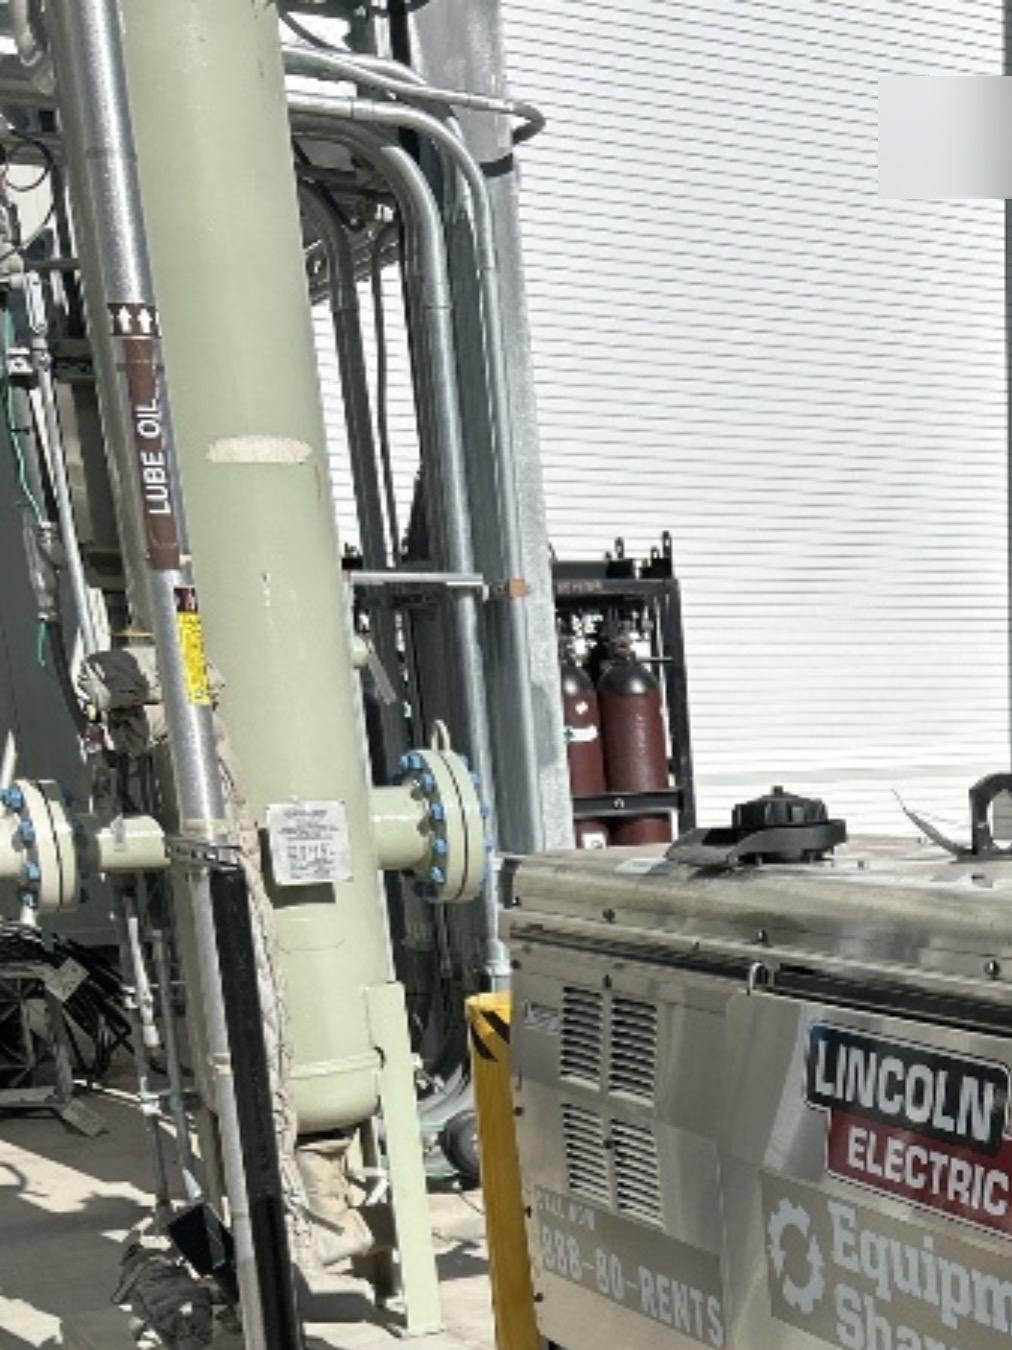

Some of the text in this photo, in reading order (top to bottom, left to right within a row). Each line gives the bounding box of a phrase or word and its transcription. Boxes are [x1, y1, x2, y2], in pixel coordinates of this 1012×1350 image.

[136, 398, 172, 516] LUBE OIL
[814, 1038, 1002, 1142] LINCOLN
[846, 1126, 1011, 1217] ELECTRIC
